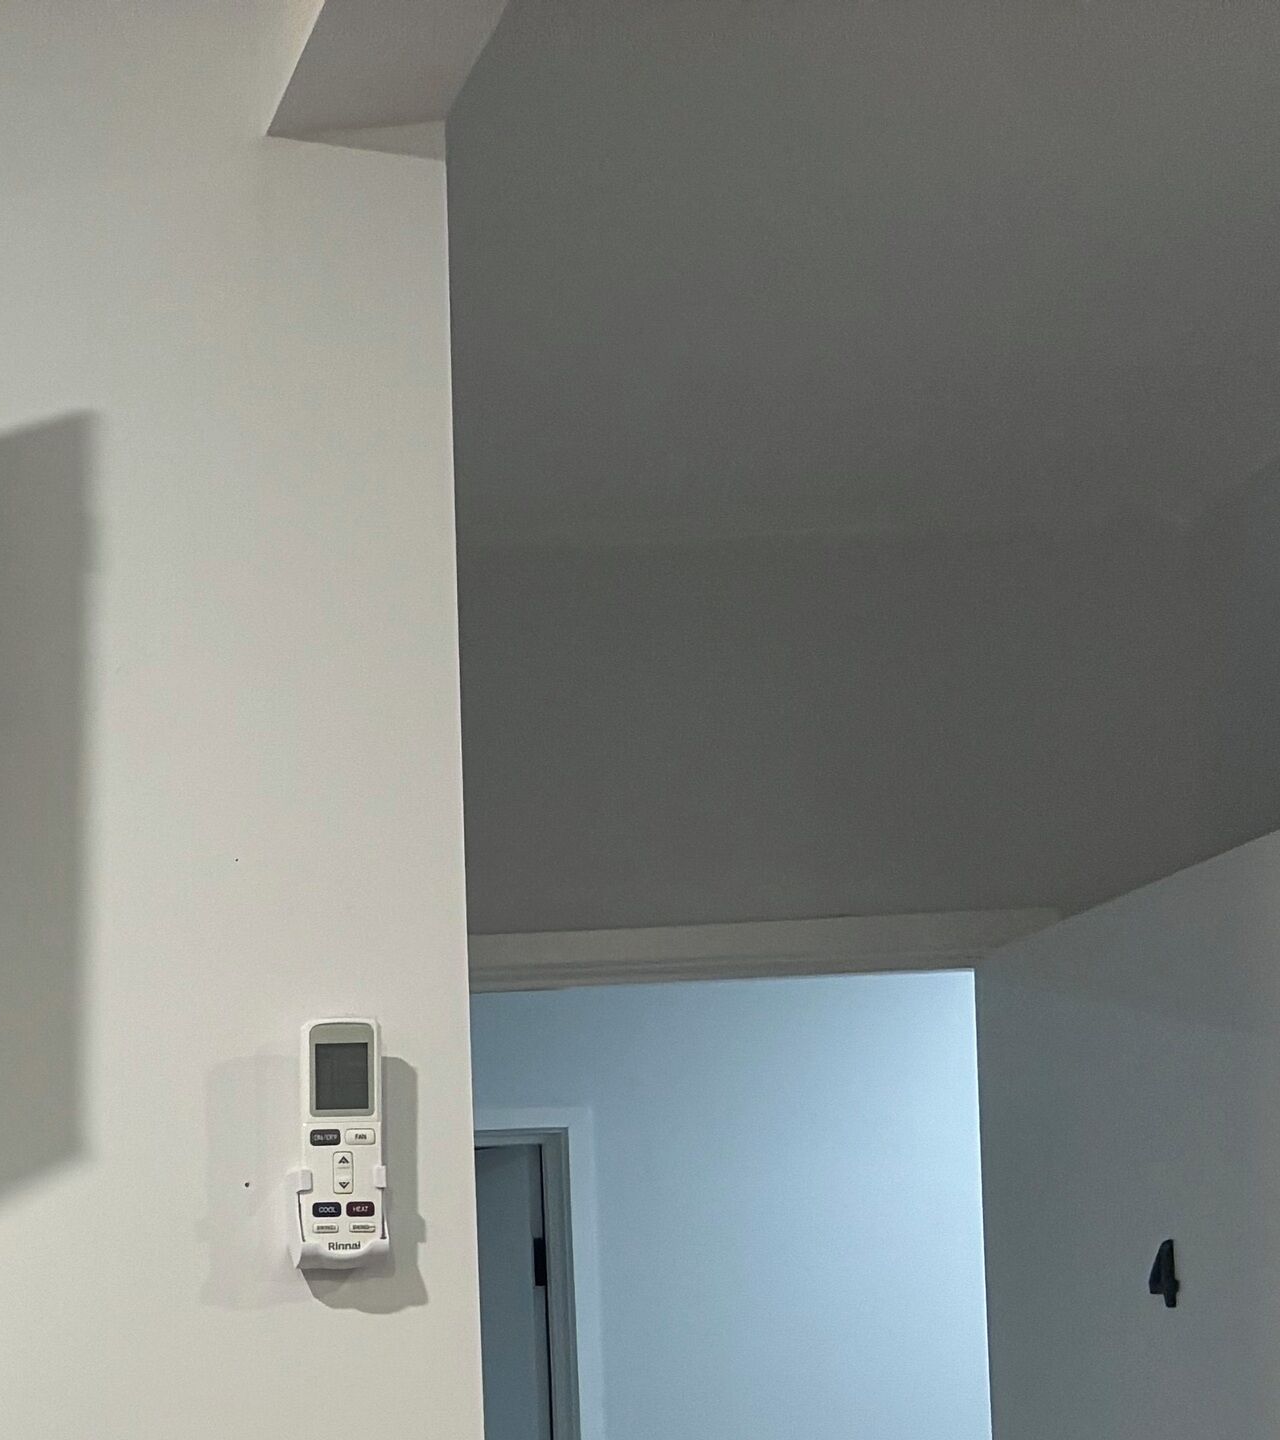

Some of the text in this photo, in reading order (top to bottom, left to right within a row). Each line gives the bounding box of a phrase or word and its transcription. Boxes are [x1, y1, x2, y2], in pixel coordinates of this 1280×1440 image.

[318, 1206, 337, 1214] COOL
[328, 1240, 361, 1251] Rinnai
[1149, 1239, 1180, 1308] 4
